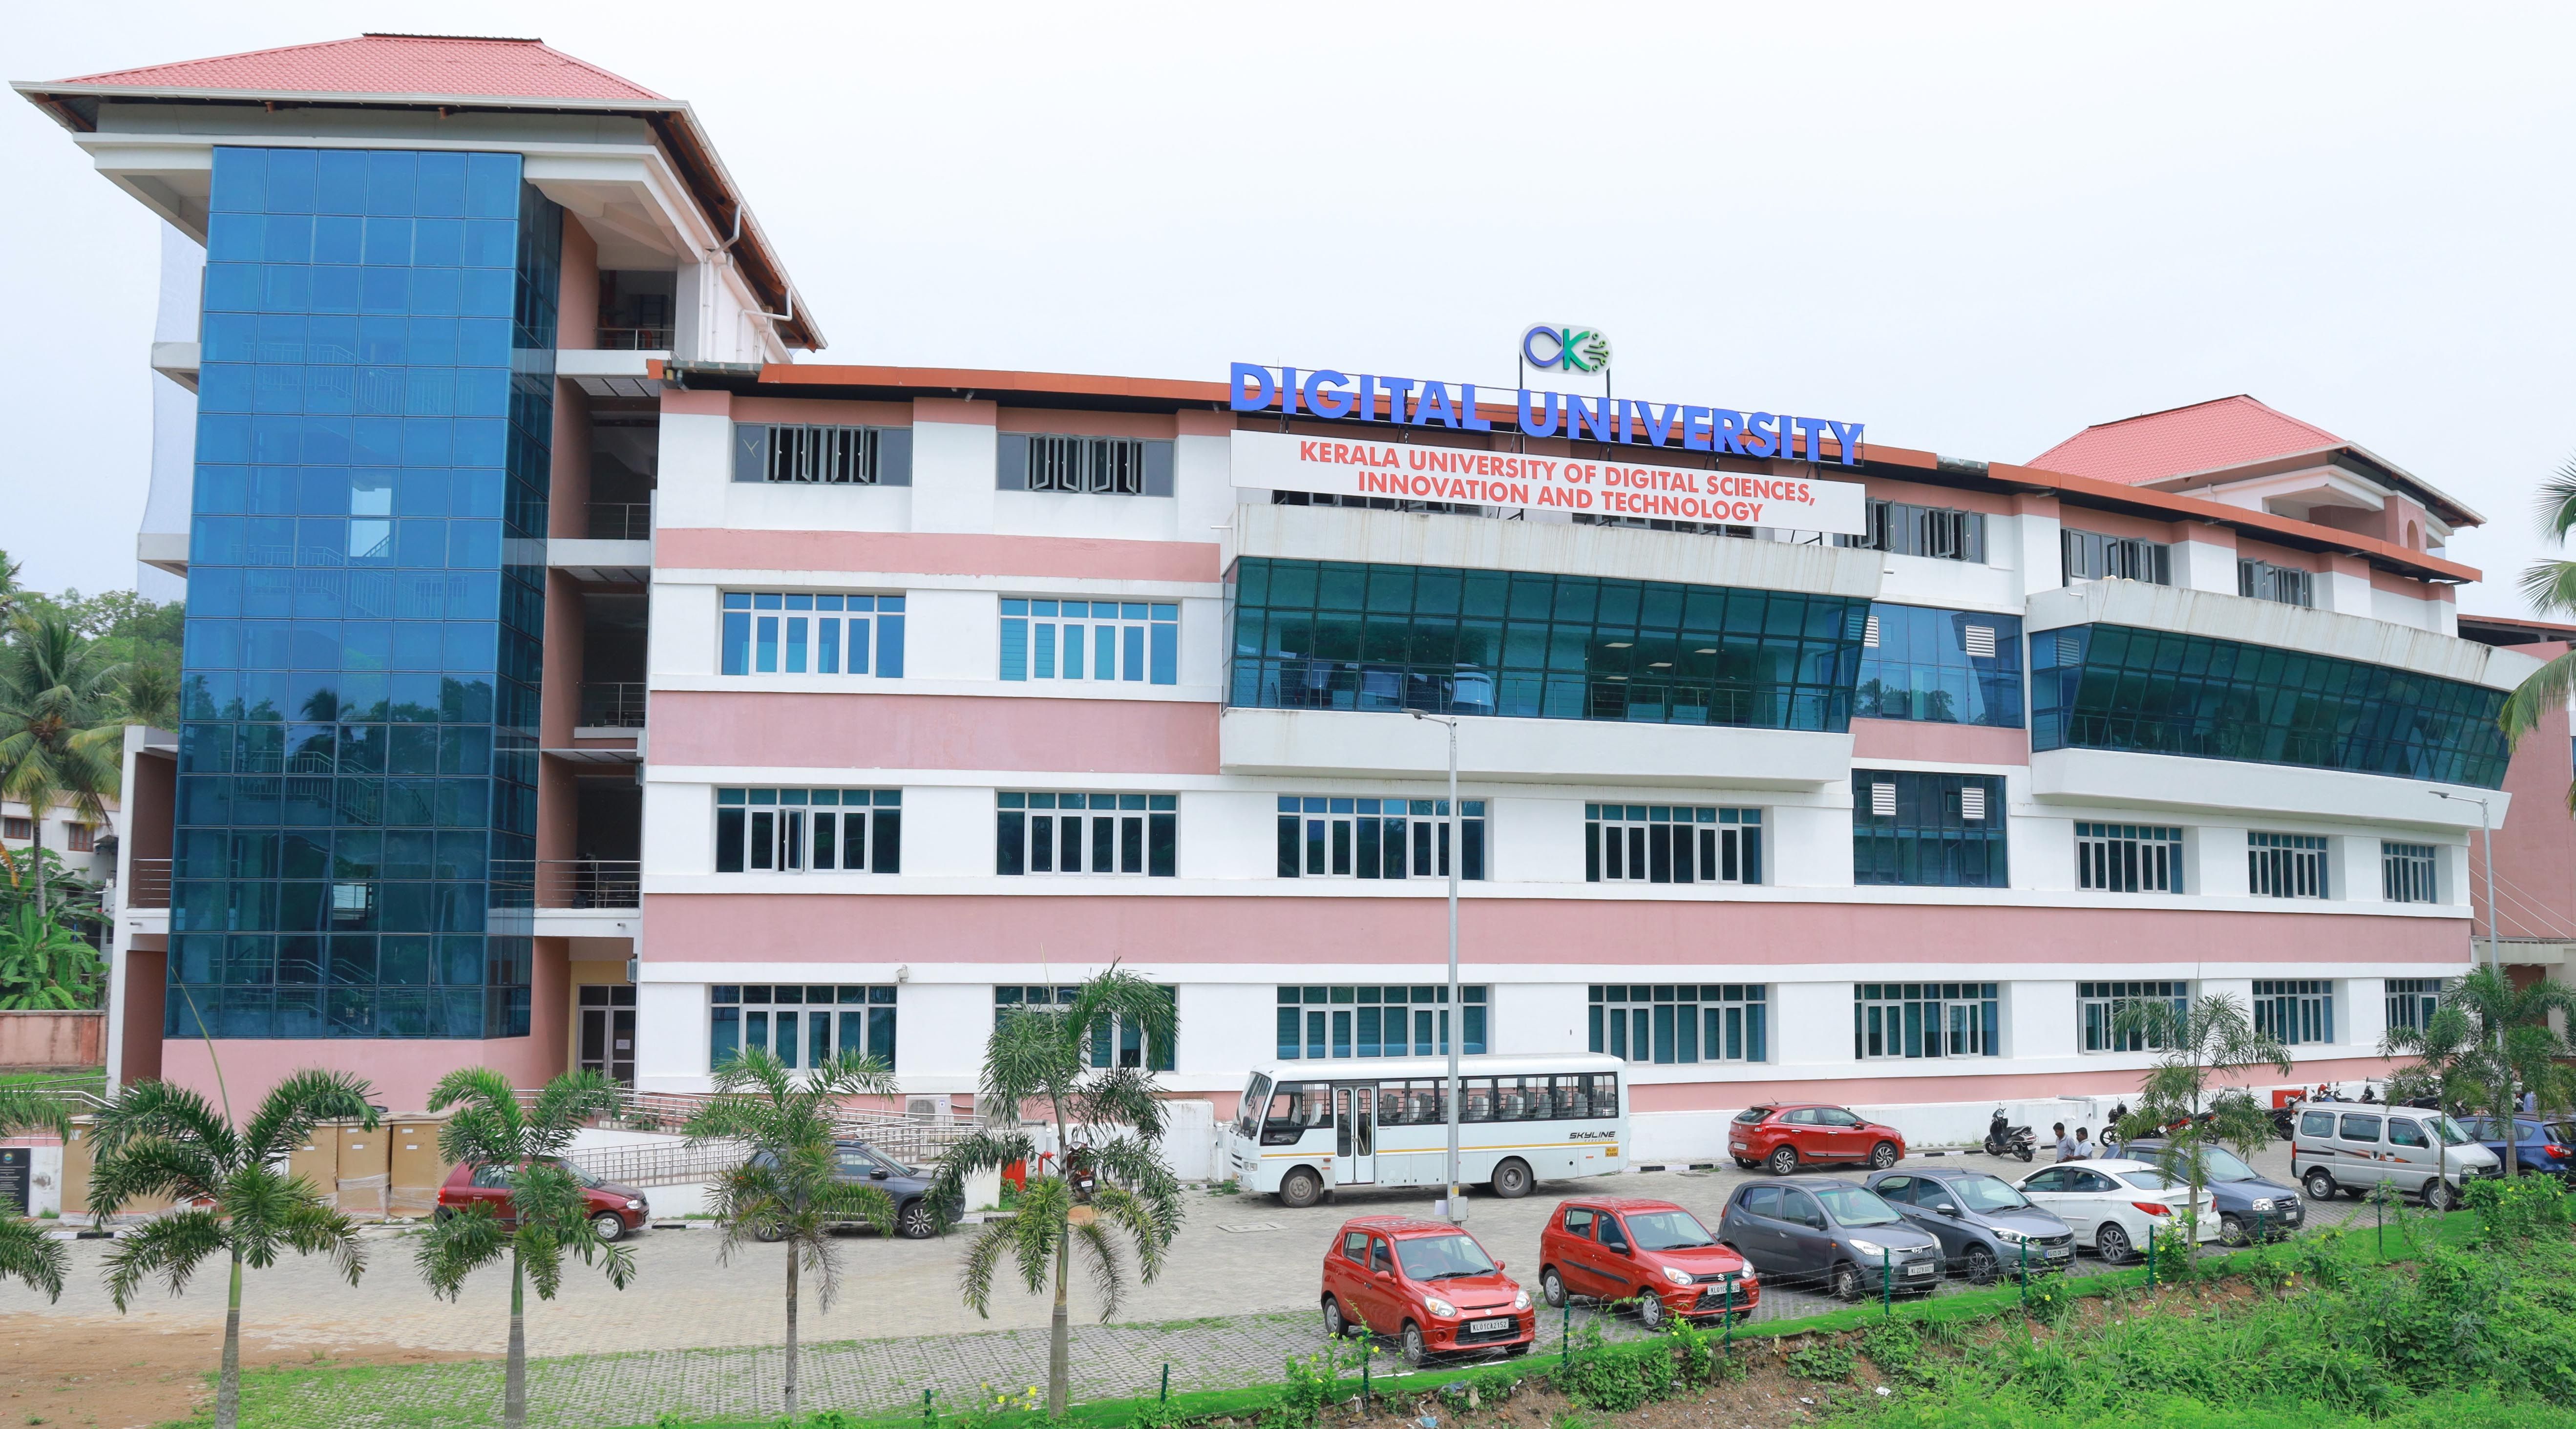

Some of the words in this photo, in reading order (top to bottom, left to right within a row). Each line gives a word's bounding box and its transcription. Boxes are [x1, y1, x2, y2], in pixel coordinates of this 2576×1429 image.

[1230, 362, 1491, 432] DIGITAL
[1518, 388, 1865, 465] UNIVERSITY
[1300, 441, 1400, 468] KERALA
[1409, 449, 1557, 481] UNIVERSITY
[1563, 463, 1597, 484] OF
[1605, 466, 1700, 493] DIGITAL
[1707, 475, 1816, 507] SCIENCES,
[1358, 471, 1529, 504] INNOVATION
[1537, 485, 1593, 509] AND
[1601, 490, 1764, 523] TECHNOLOGY
[1473, 1321, 1507, 1331] KL01CA2152
